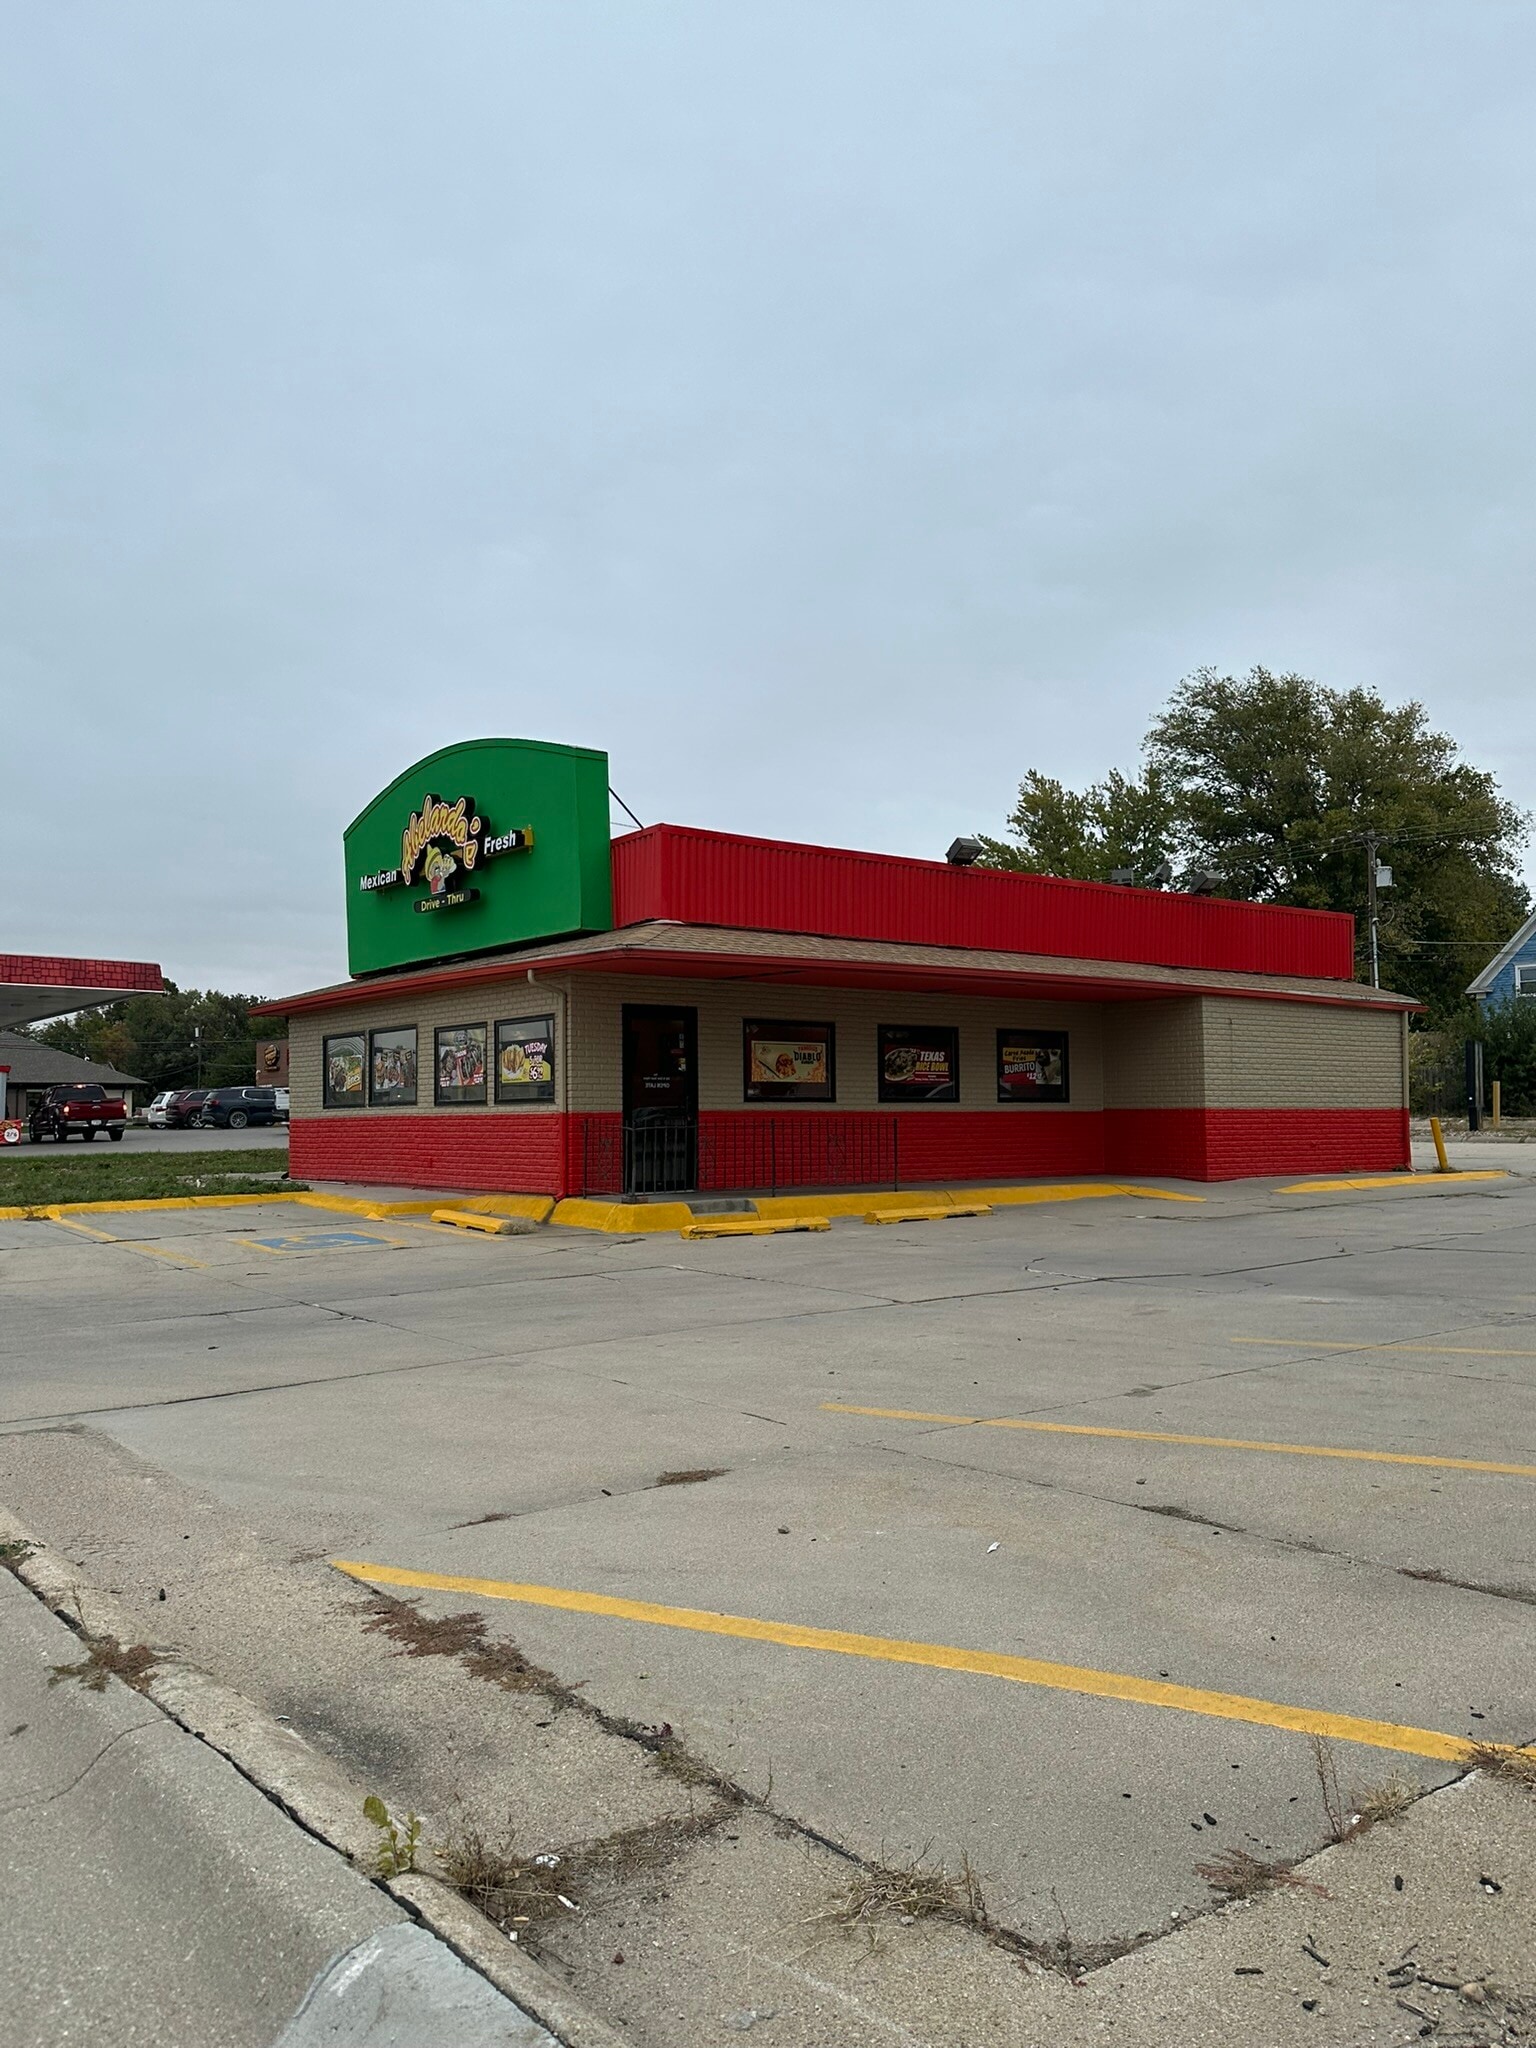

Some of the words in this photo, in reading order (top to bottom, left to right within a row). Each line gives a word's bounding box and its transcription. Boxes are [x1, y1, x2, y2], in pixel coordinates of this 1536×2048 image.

[484, 830, 516, 854] Fresh
[360, 870, 397, 891] Mexican
[421, 897, 440, 911] Drive
[447, 893, 464, 906] Thru
[524, 1042, 548, 1054] TUESDAY
[793, 1050, 823, 1062] DIABLO
[920, 1051, 945, 1062] TEXAS
[915, 1061, 930, 1071] RICE
[931, 1062, 949, 1072] BOWL
[1004, 1062, 1035, 1074] BURRITO
